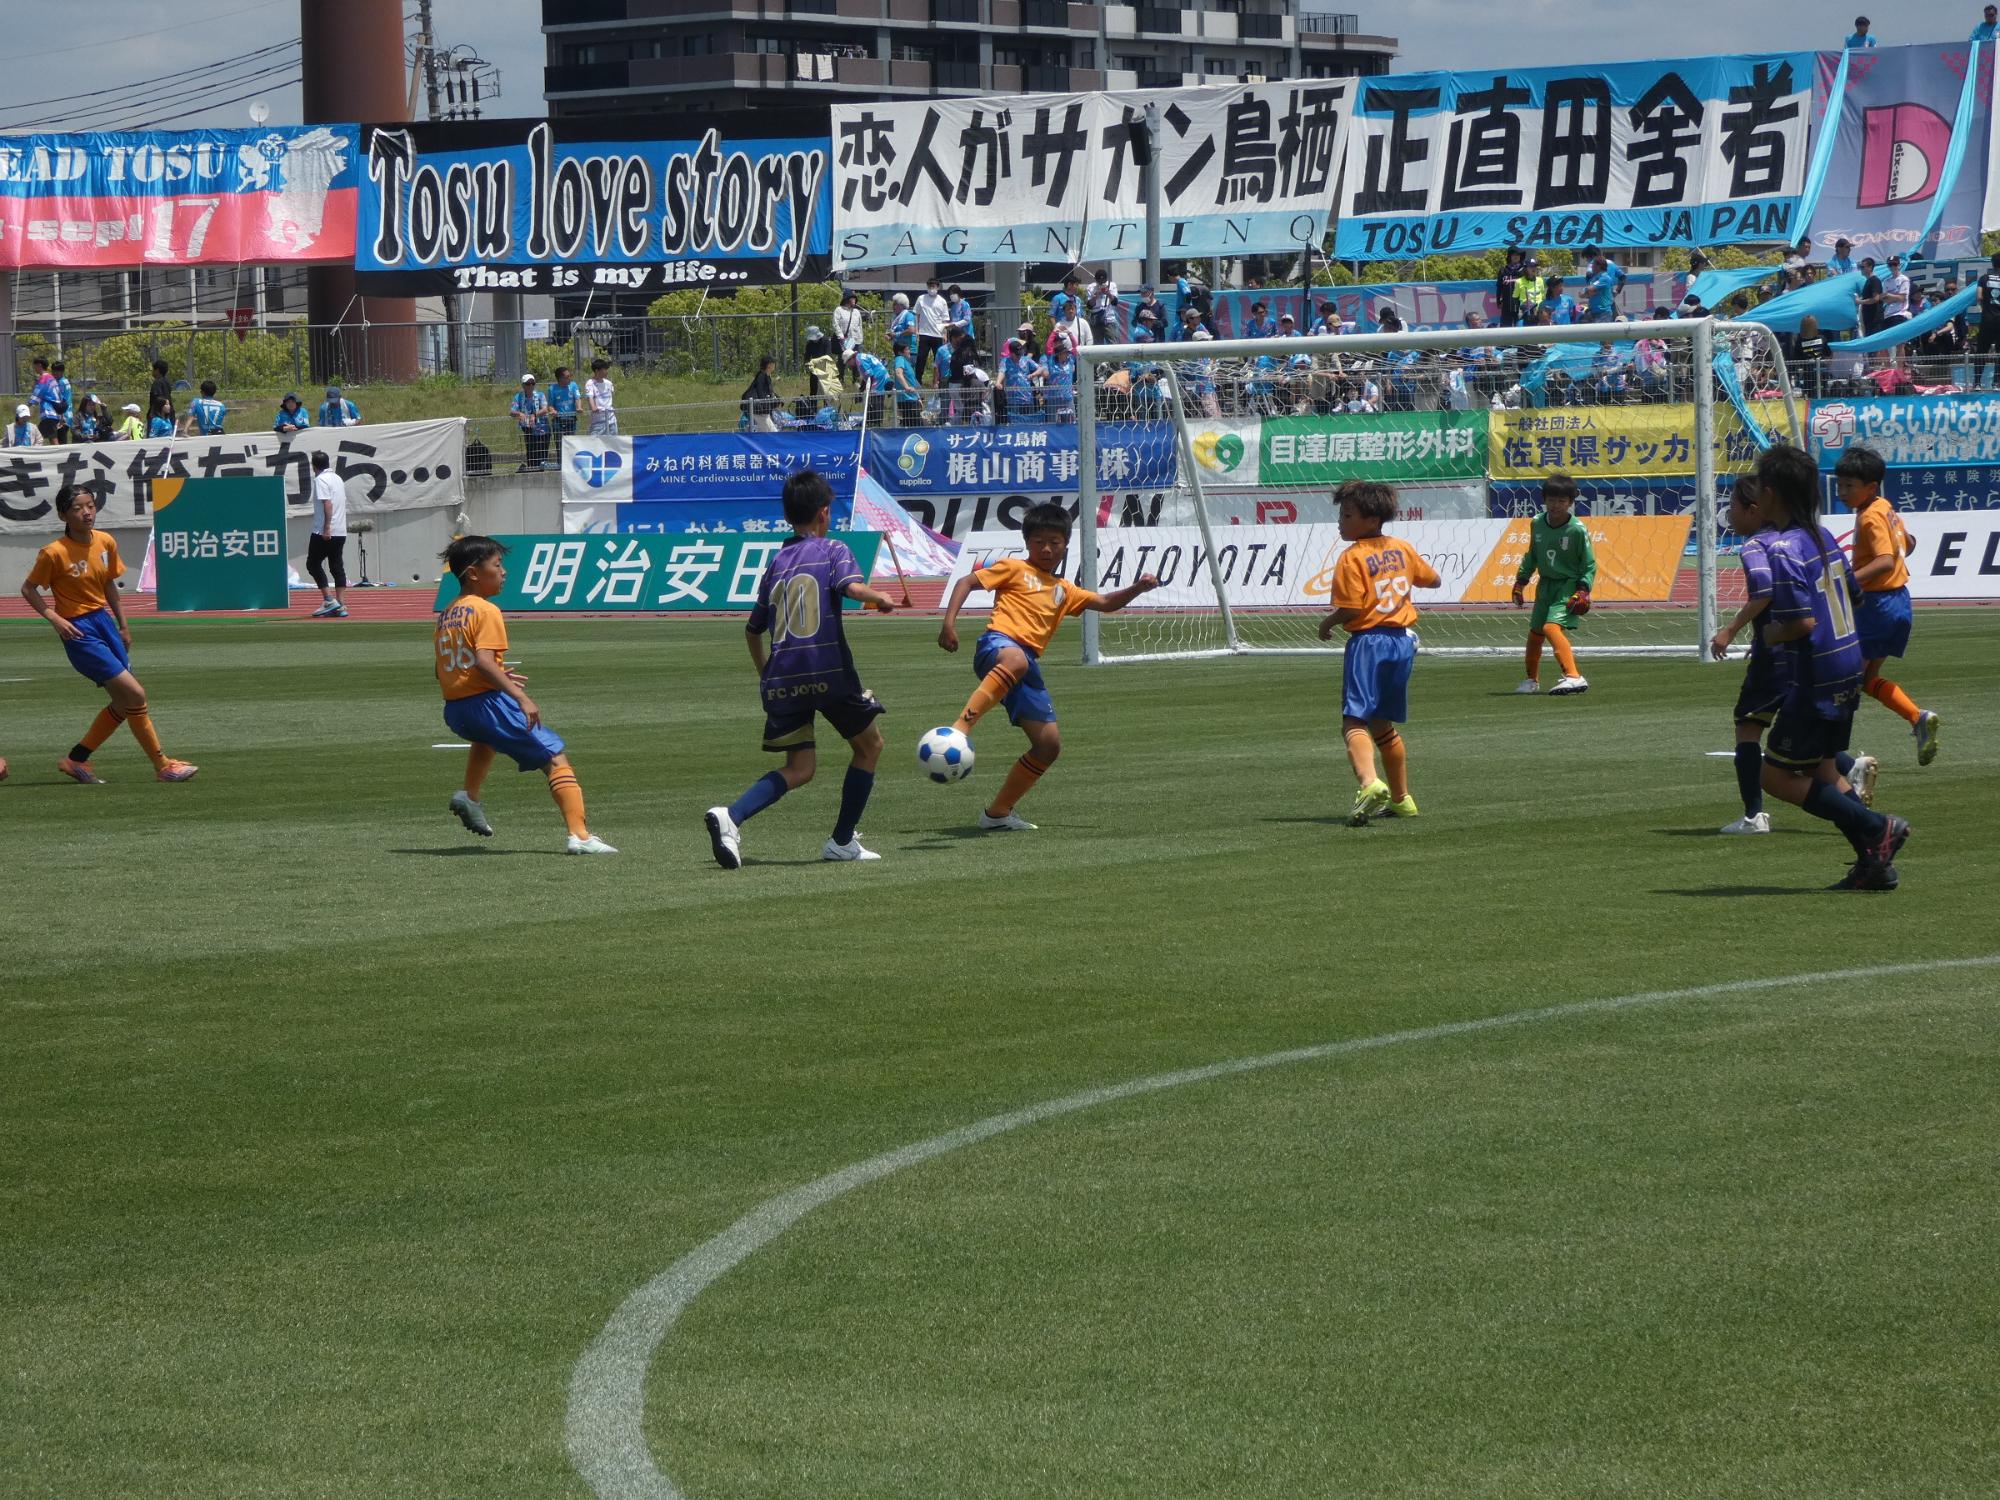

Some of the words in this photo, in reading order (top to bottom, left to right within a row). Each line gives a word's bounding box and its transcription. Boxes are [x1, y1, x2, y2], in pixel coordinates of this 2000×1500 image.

[1353, 59, 1799, 216] 正直田舎者
[103, 142, 226, 183] TOSU
[1889, 143, 1904, 200] dix-sept
[369, 127, 512, 264] Tosu
[527, 121, 651, 259] love
[662, 127, 824, 280] story
[144, 198, 220, 258] 17
[841, 226, 1073, 262] SAGAN
[1109, 214, 1321, 251] TINO
[1362, 217, 1459, 254] TOSU
[1501, 212, 1603, 248] SAGA
[454, 265, 538, 289] That
[551, 265, 579, 287] is
[593, 266, 652, 288] my
[662, 260, 748, 283] life...
[203, 405, 221, 426] 17
[1504, 416, 1596, 431] 一般社団法人
[946, 431, 1047, 449] サプリコ鳥栖
[1271, 428, 1474, 464] 目達原整形外科
[646, 452, 861, 472] みね内科循環器科クリニック
[660, 475, 687, 483] MINE
[690, 473, 766, 483] Cardiovascular
[818, 471, 846, 479] Clinic
[947, 447, 1141, 485] 梶山商事株)
[161, 529, 280, 559] 明治安田
[1546, 549, 1556, 567] 9
[70, 560, 88, 577] 39
[521, 539, 783, 605] 明治安田
[769, 573, 820, 644] 10
[1375, 576, 1410, 614] 59
[440, 633, 477, 672] 56
[767, 688, 787, 701] FC
[790, 682, 828, 697] JOTO
